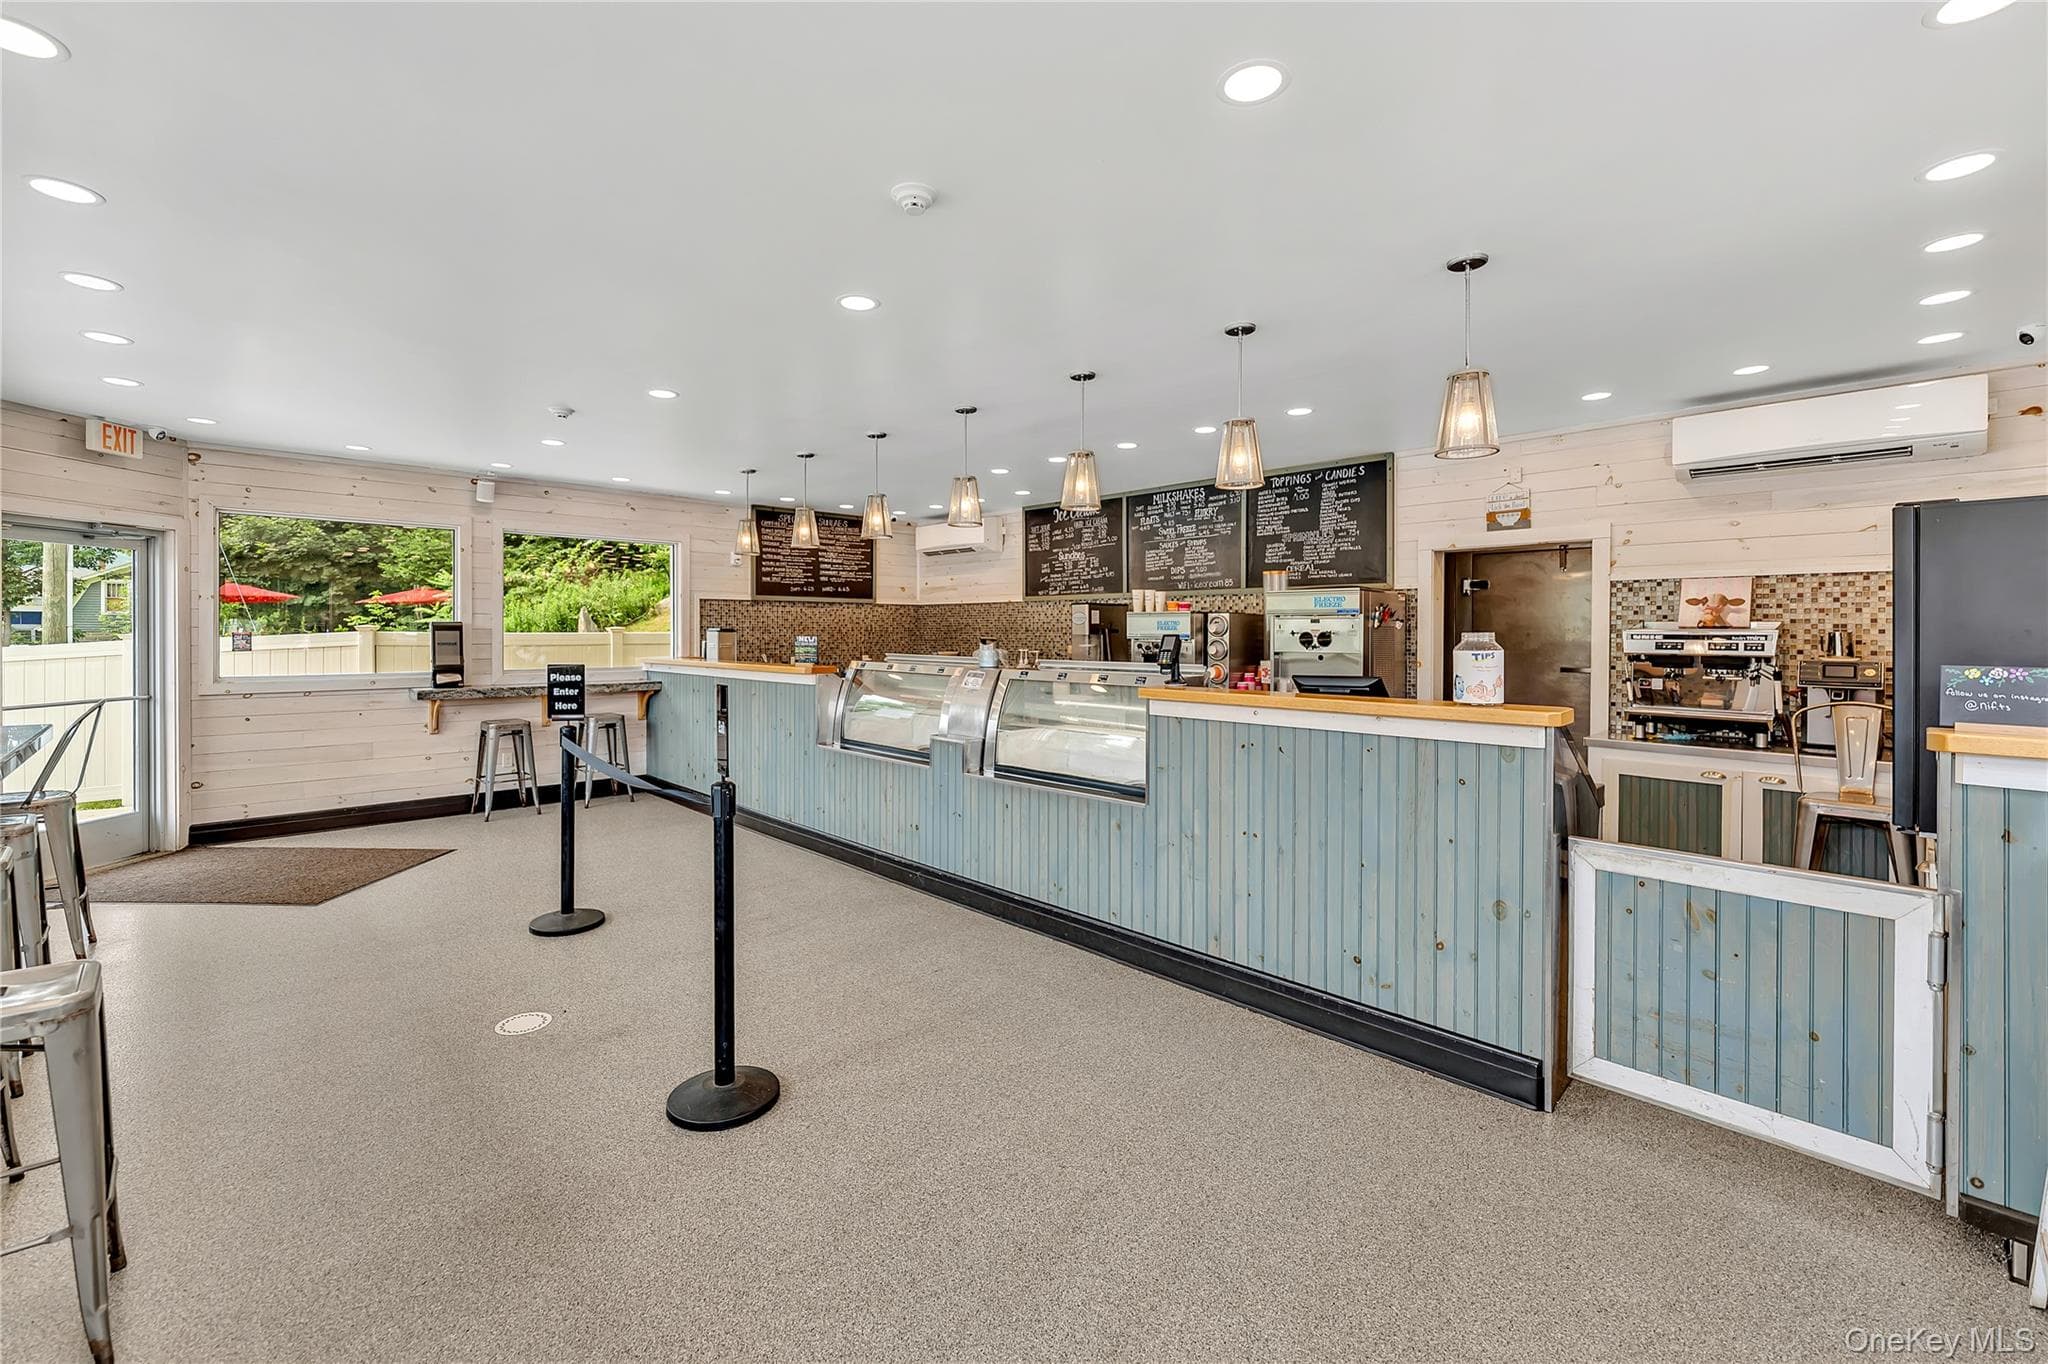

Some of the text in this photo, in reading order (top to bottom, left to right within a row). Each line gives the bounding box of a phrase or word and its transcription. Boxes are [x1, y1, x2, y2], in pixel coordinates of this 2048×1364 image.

[102, 422, 137, 455] EXIT
[1270, 473, 1312, 488] TOPPINGS
[1325, 465, 1366, 481] CANDIES
[1152, 487, 1206, 505] MILKSHAKES
[1053, 508, 1069, 523] Ice
[1170, 566, 1186, 575] DIPS
[1471, 652, 1496, 661] TIPS
[550, 673, 582, 682] Please
[553, 687, 579, 696] Enter
[554, 701, 578, 710] Here
